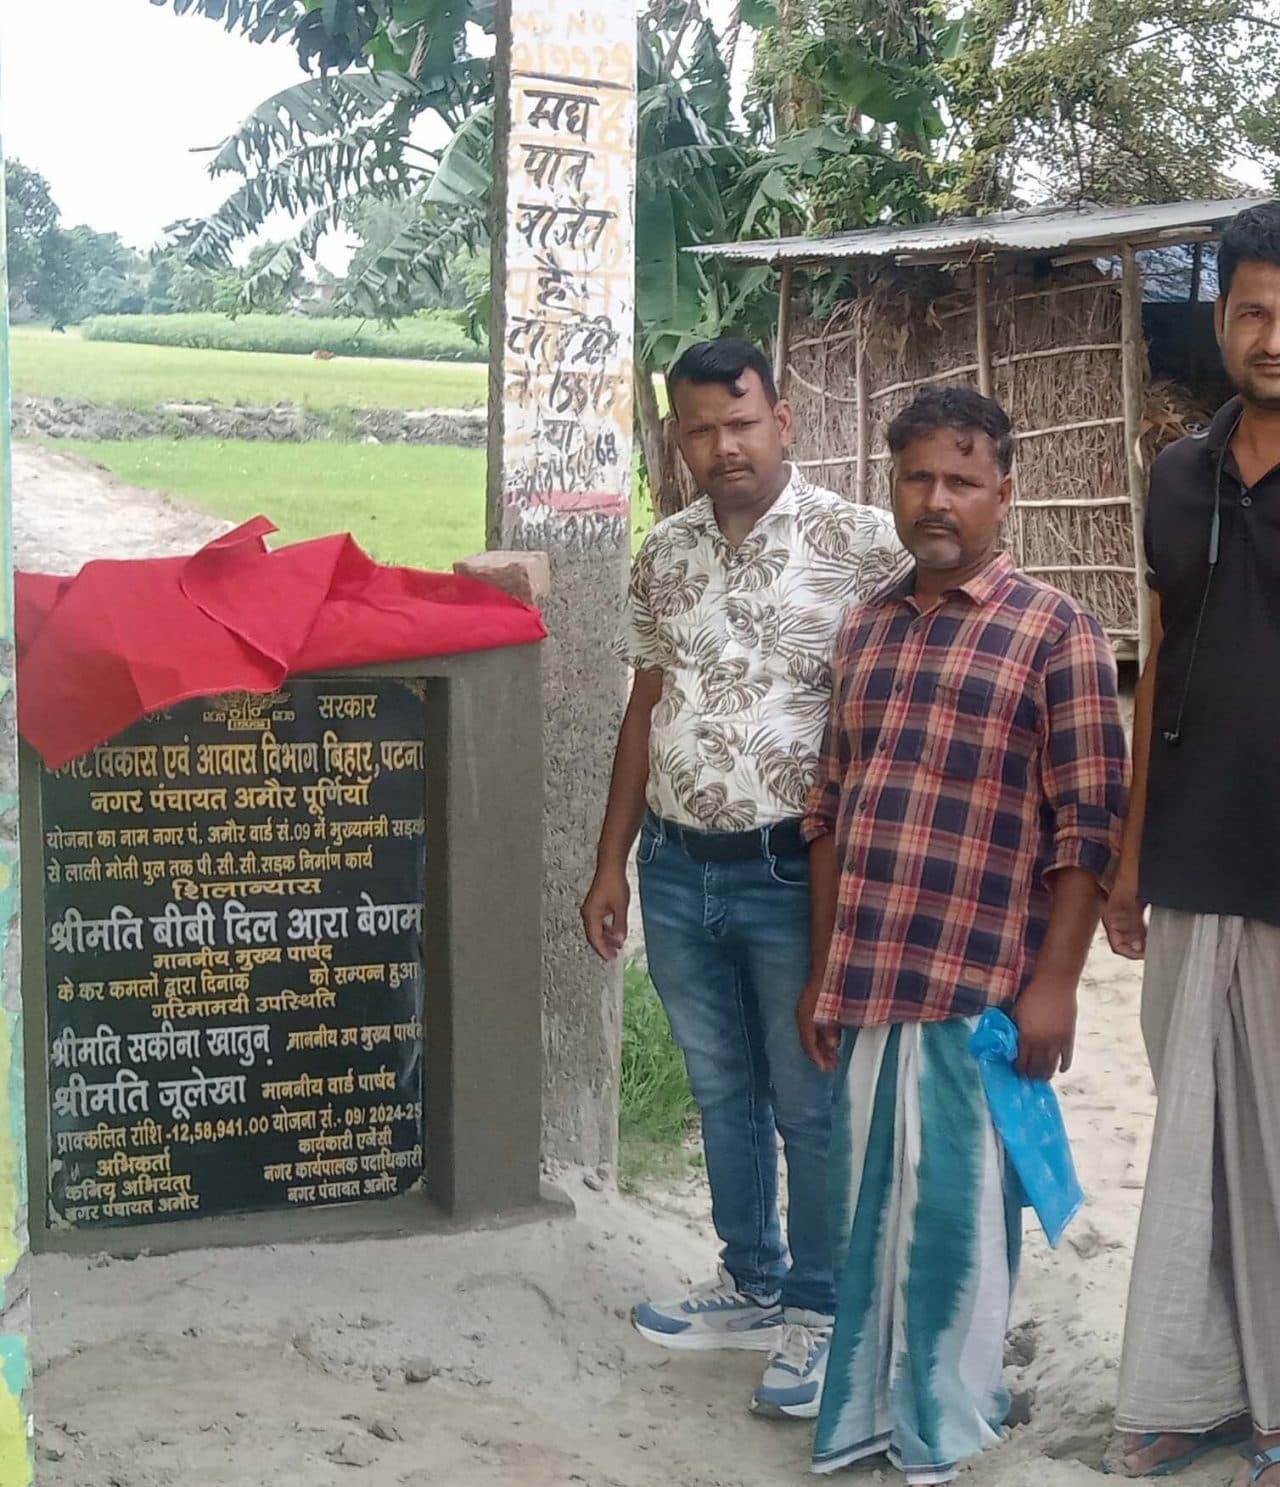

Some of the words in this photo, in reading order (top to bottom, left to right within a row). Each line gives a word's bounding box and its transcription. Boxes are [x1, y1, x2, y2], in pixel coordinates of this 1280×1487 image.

[317, 694, 378, 719] सरकार
[163, 735, 190, 779] एवं
[197, 743, 257, 776] आवास
[262, 731, 318, 775] विभाग
[380, 741, 424, 770] पटना
[90, 790, 144, 813] नगर
[150, 783, 227, 811] पंचायत
[234, 777, 296, 809] अमौर
[47, 825, 93, 849] योजना
[97, 829, 116, 847] का
[120, 828, 149, 846] नाम
[153, 827, 184, 845] नगर
[208, 818, 246, 843] अमौर
[250, 816, 273, 842] वार्ड
[313, 815, 326, 840] में
[329, 813, 388, 846] मुख्यमंत्री
[47, 857, 61, 883] से
[65, 855, 102, 882] लाली
[105, 854, 138, 880] मोती
[143, 860, 165, 886] पुल
[169, 860, 193, 877] तक
[299, 846, 340, 872] निर्माण
[344, 844, 373, 870] कार्य
[172, 878, 322, 900] शिलान्यास
[49, 905, 144, 952] श्रीमति
[149, 902, 216, 948] बीबी
[223, 900, 277, 945] दिल
[287, 906, 349, 939] आरा
[356, 891, 424, 936] बेगम
[153, 946, 230, 970] माननीय
[235, 946, 282, 971] मुख्य
[287, 938, 333, 962] पार्षद
[57, 976, 74, 1002] के
[79, 982, 104, 1001] कर
[164, 976, 196, 998] द्वारा
[201, 968, 250, 994] दिनांक
[309, 961, 329, 986] को
[334, 963, 385, 985] सम्पन्न
[389, 961, 419, 988] हुआ
[152, 993, 250, 1019] गरिमामयी
[256, 988, 337, 1013] उपस्थिति
[51, 1024, 121, 1068] श्रीमति
[127, 1020, 200, 1063] सकीना
[287, 1024, 338, 1050] माननीय
[341, 1027, 357, 1046] उप
[360, 1025, 391, 1051] मुख्य
[52, 1069, 149, 1117] श्रीमति
[158, 1066, 247, 1119] जूलेखा
[262, 1073, 323, 1100] माननीय
[328, 1068, 354, 1094] वार्ड
[358, 1065, 396, 1091] पार्षद
[272, 1105, 316, 1132] योजना
[298, 1128, 353, 1154] कार्यकारी
[96, 1146, 170, 1176] अभिकर्ता
[264, 1163, 292, 1182] नगर
[295, 1152, 358, 1179] कार्यपालक
